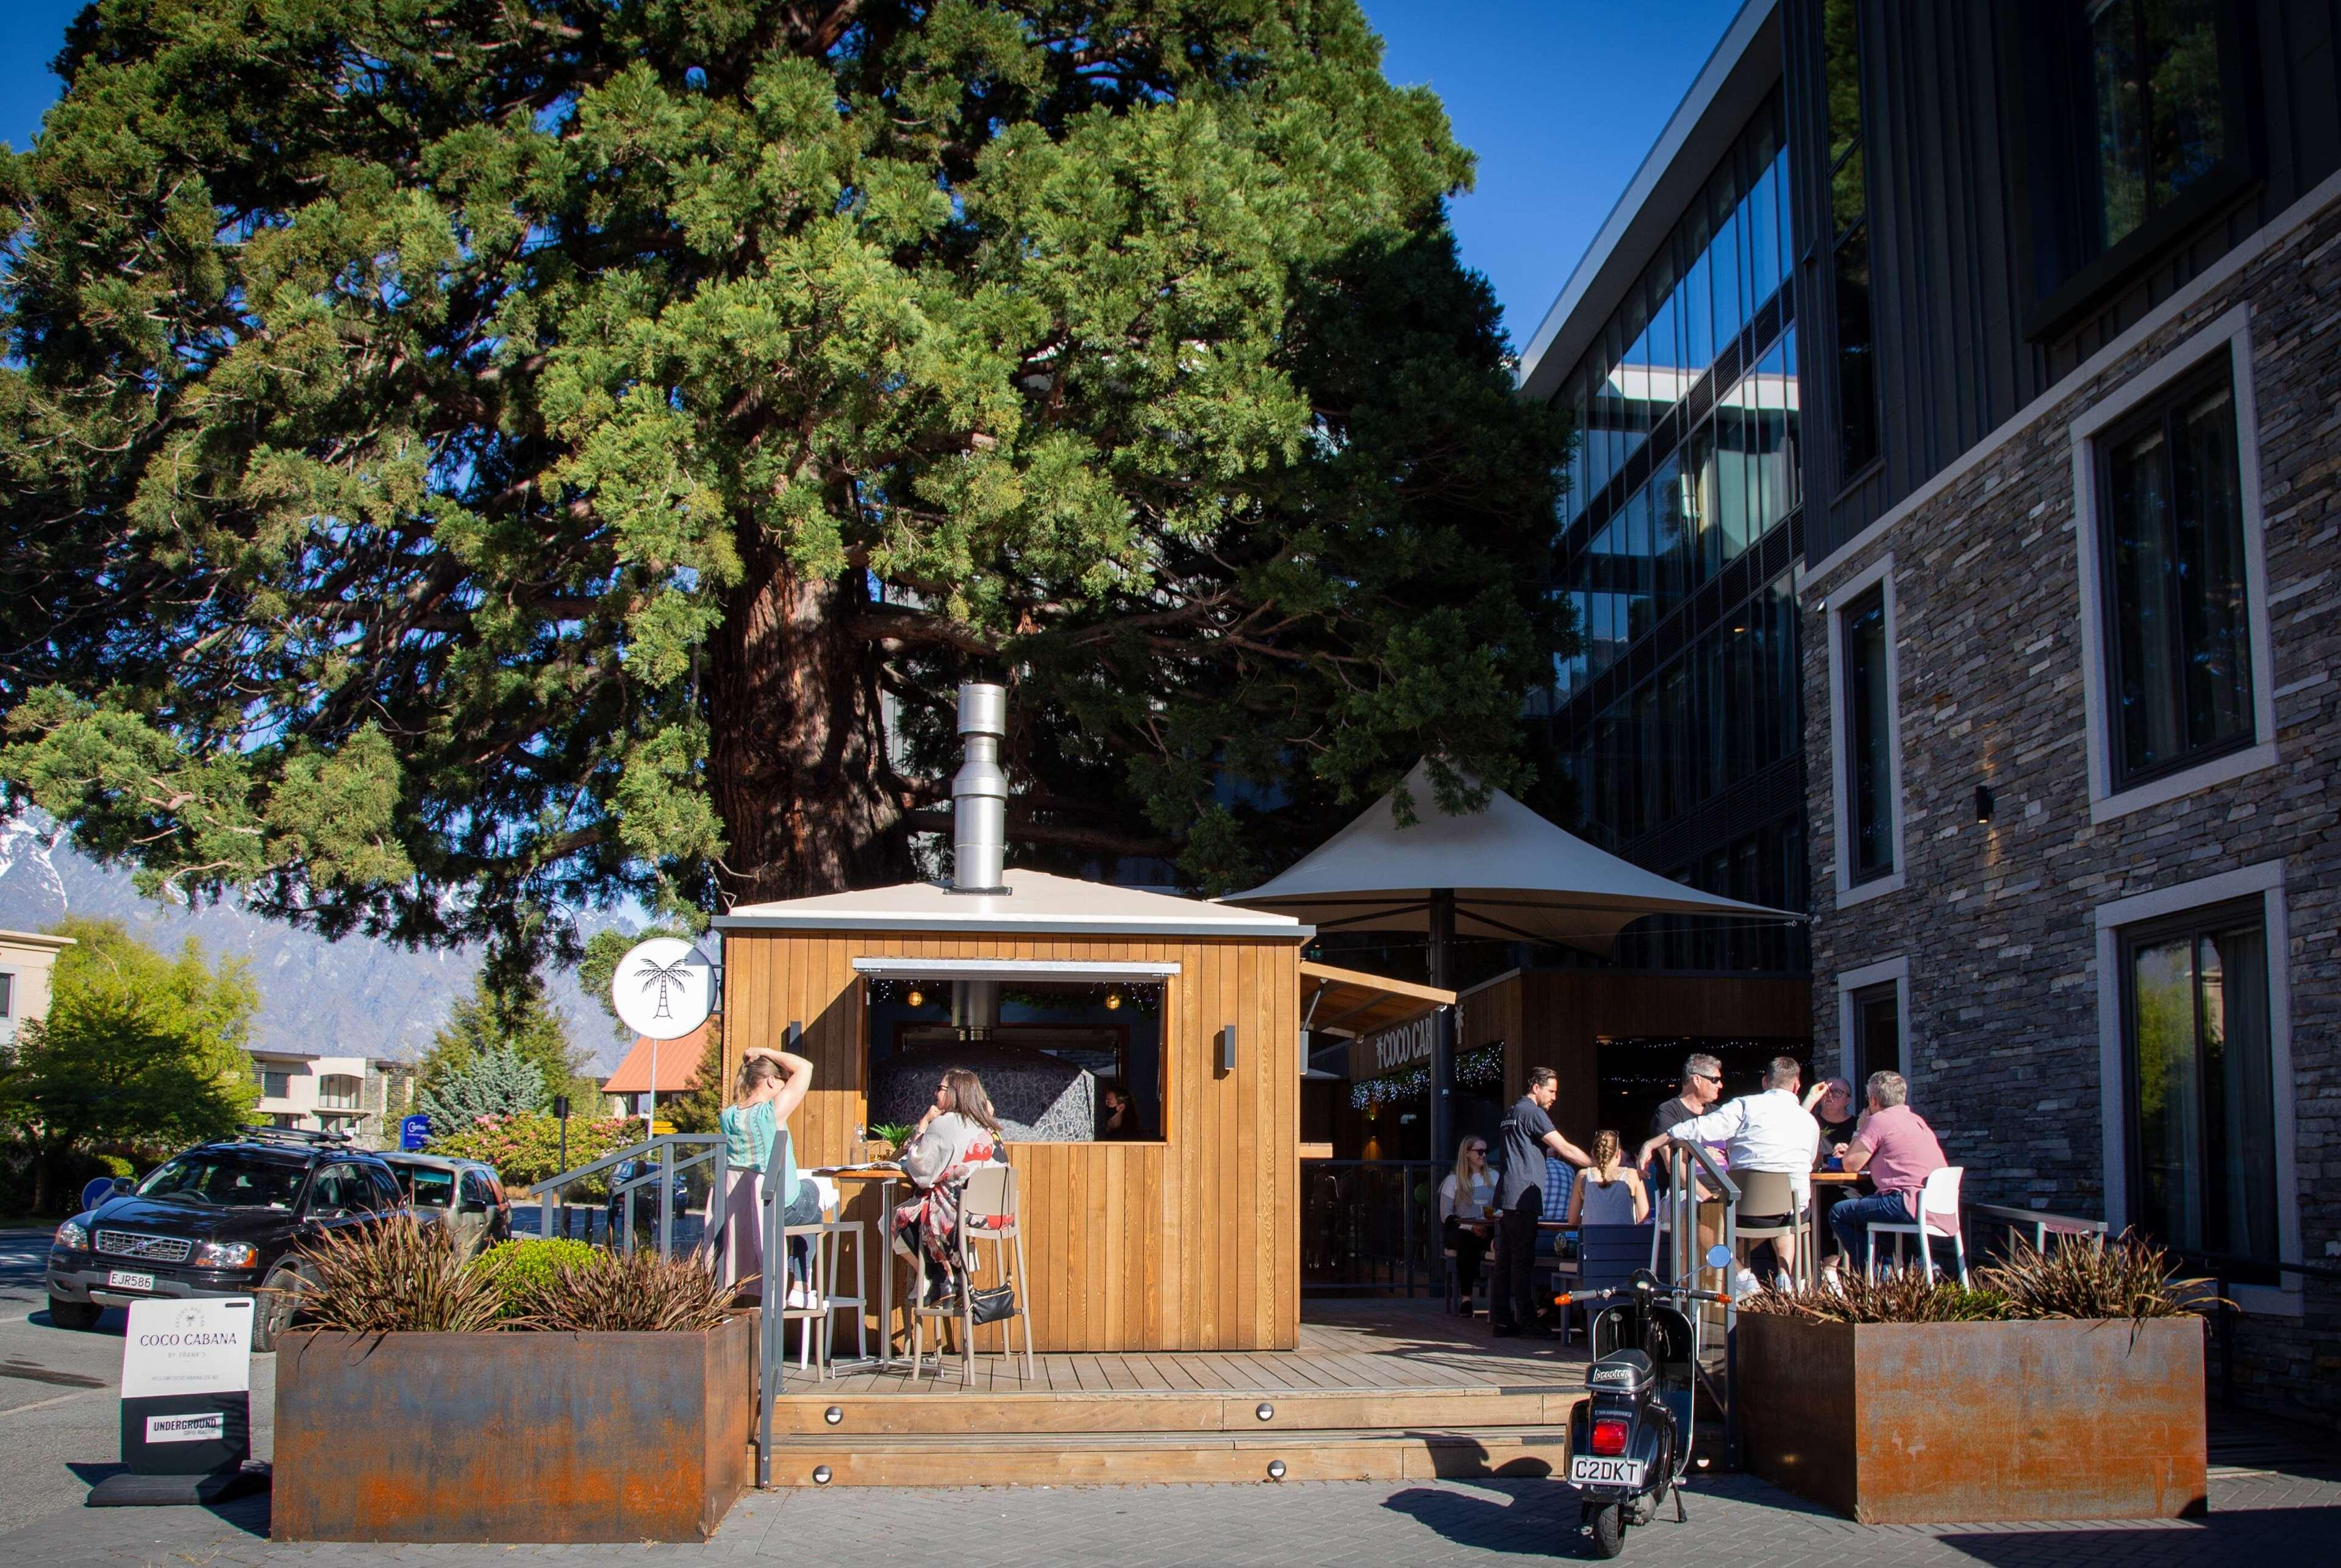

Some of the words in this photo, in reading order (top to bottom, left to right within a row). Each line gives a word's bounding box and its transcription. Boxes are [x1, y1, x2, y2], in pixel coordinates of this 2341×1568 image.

[1383, 1026, 1411, 1068] COCO
[1412, 1017, 1432, 1059] CAB
[112, 1274, 151, 1288] EJR586
[141, 1334, 180, 1347] COCO
[184, 1333, 237, 1345] CABANA
[154, 1418, 216, 1431] UNDERGROUND
[1576, 1461, 1638, 1481] C2DKT
